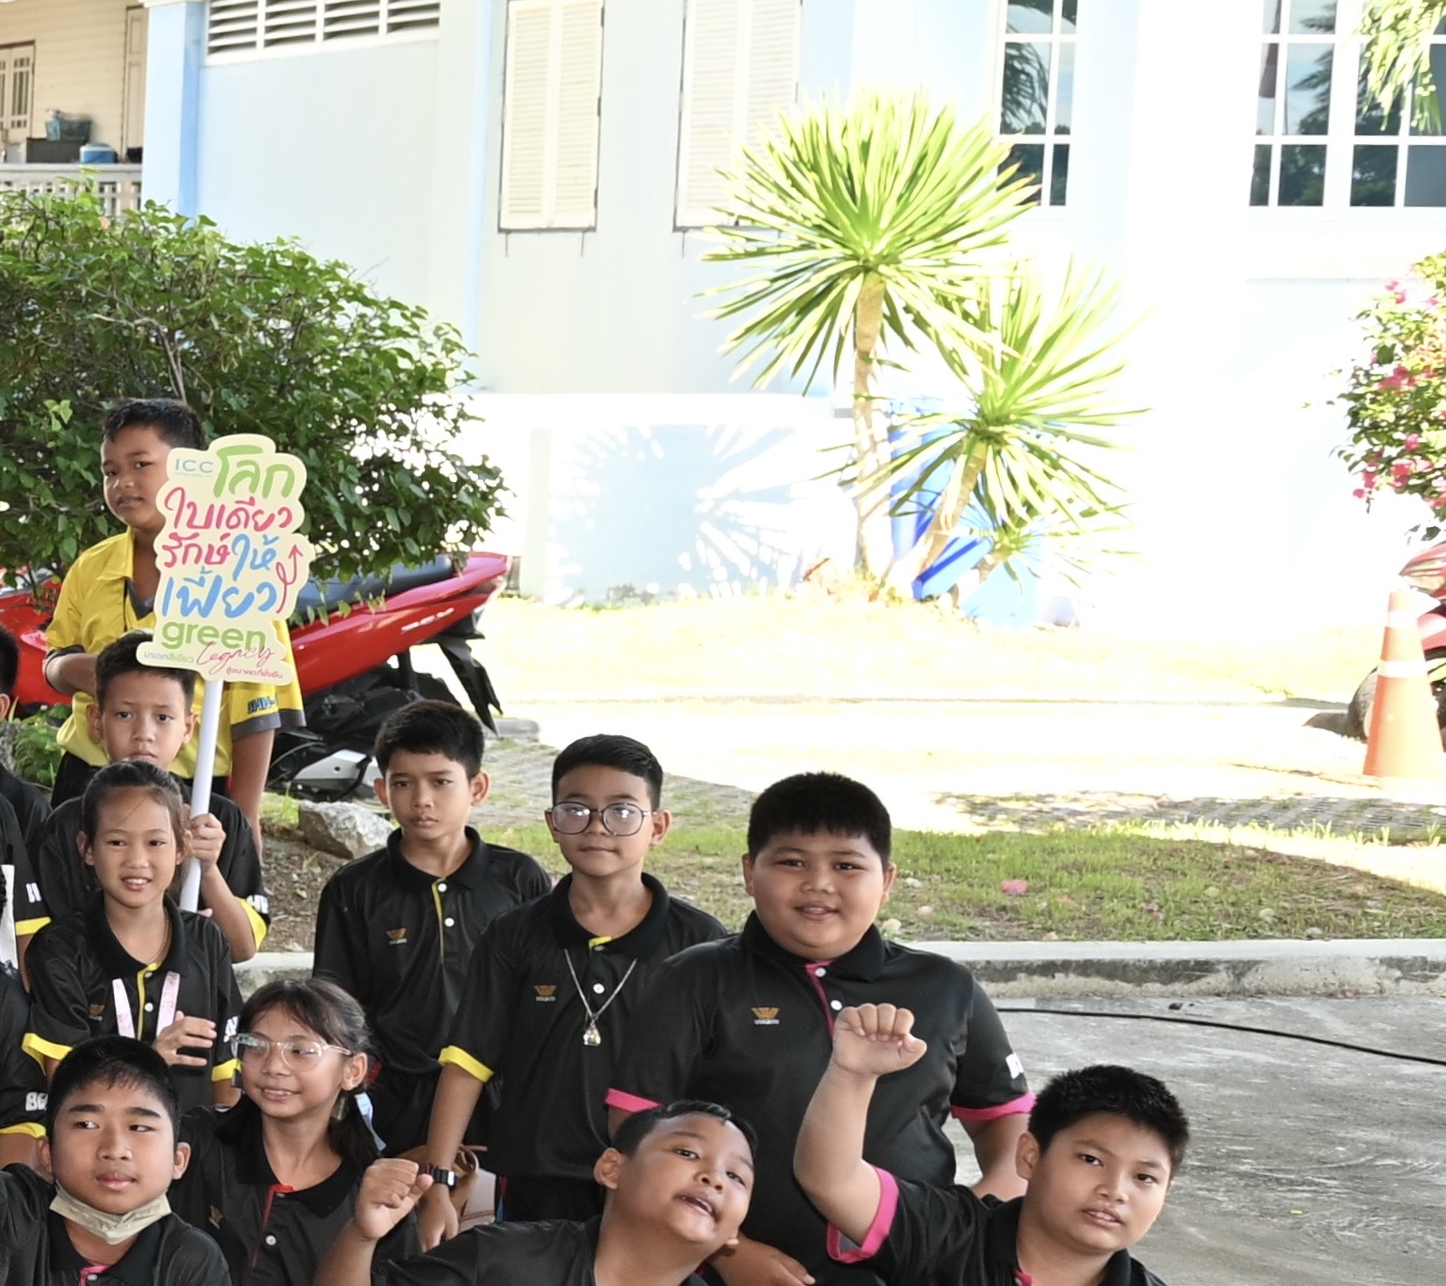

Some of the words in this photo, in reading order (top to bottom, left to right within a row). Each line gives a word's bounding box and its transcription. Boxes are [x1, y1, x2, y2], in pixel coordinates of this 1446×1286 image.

[175, 458, 213, 473] ICC
[213, 444, 295, 499] โลก
[164, 487, 292, 532] ใบเดียว
[162, 532, 279, 582] รักษ์ให้
[162, 566, 277, 618] เฟี้ยว
[162, 620, 266, 650] green
